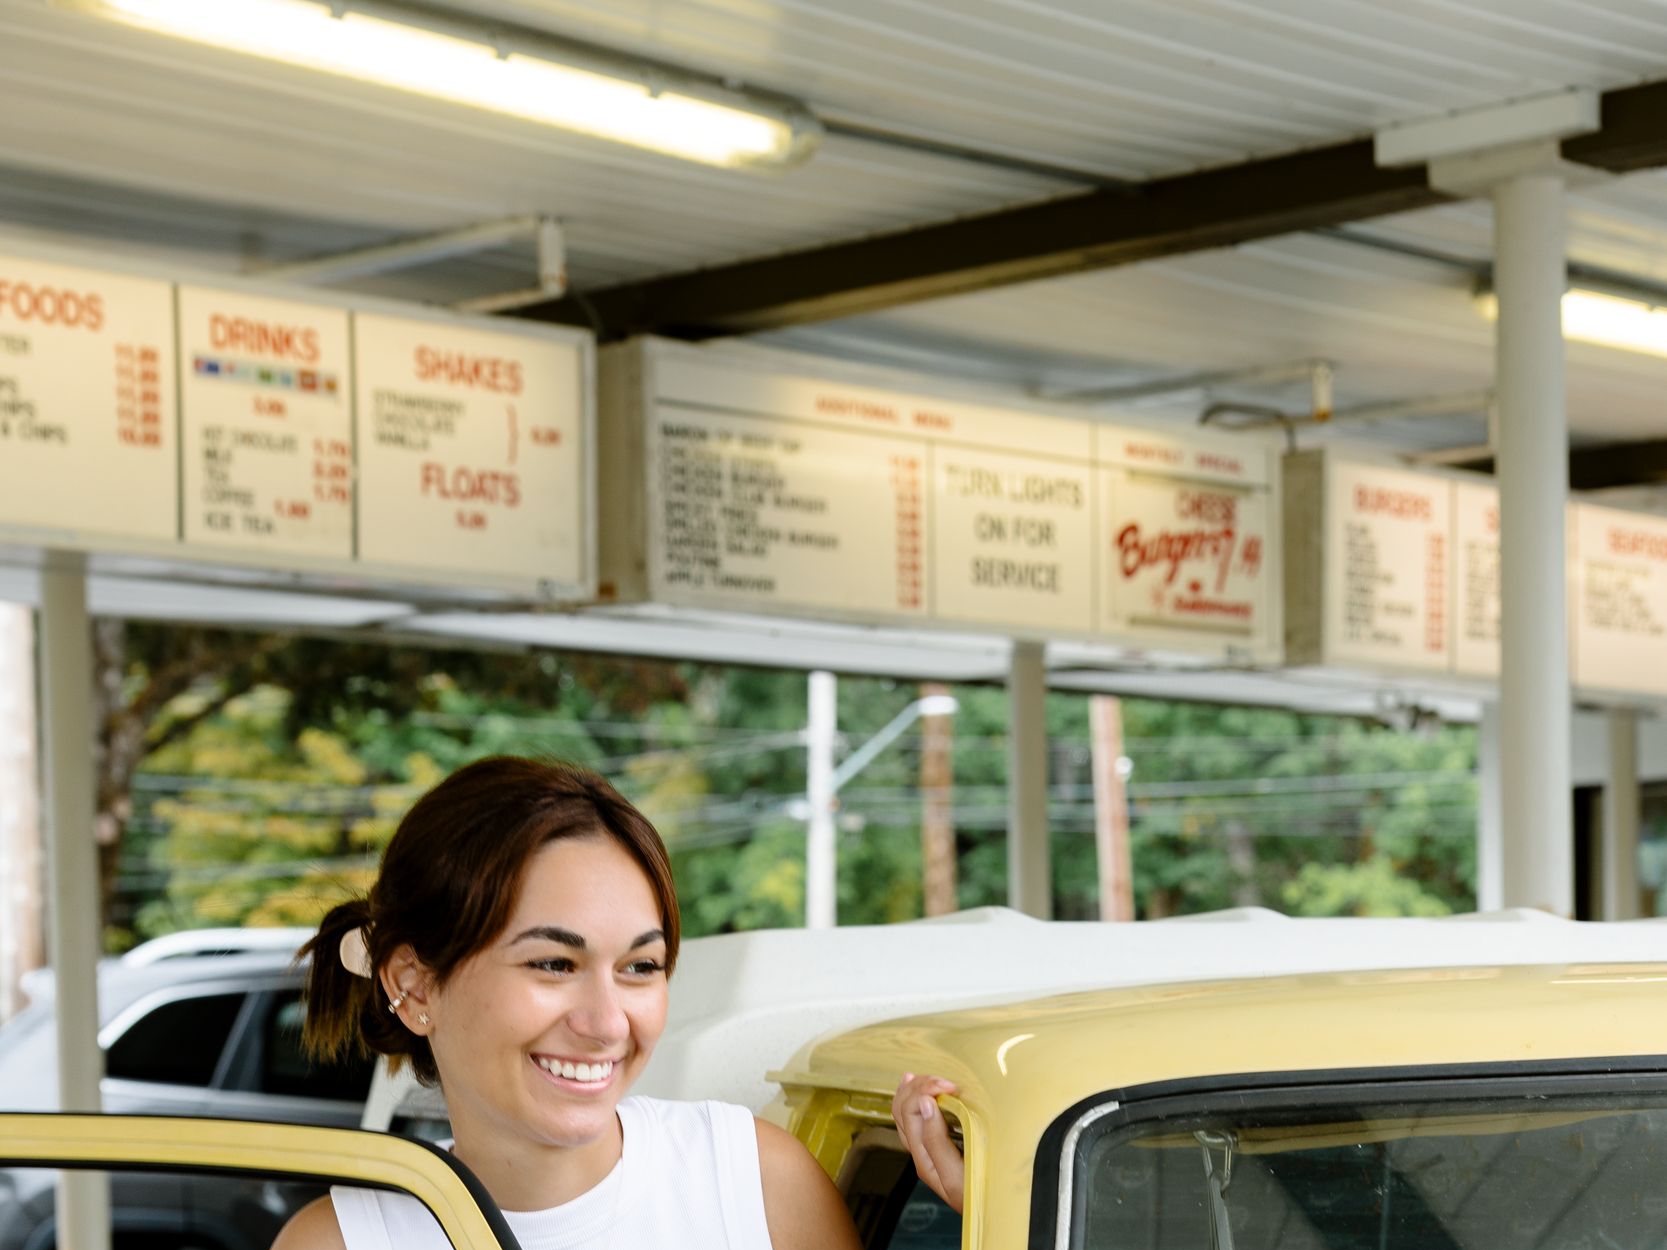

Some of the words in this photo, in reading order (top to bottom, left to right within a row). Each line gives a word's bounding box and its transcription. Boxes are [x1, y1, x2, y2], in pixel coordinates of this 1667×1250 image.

[209, 315, 320, 362] DRINKS
[415, 345, 523, 396] SHAKES
[912, 410, 953, 431] MENU
[421, 461, 521, 508] FLOATS
[945, 463, 1003, 497] TURN
[1009, 474, 1084, 510] LIGHTS
[242, 515, 275, 535] TEA
[974, 512, 1007, 541] ON
[1014, 517, 1057, 546] FOR
[971, 555, 1061, 594] SERVICE
